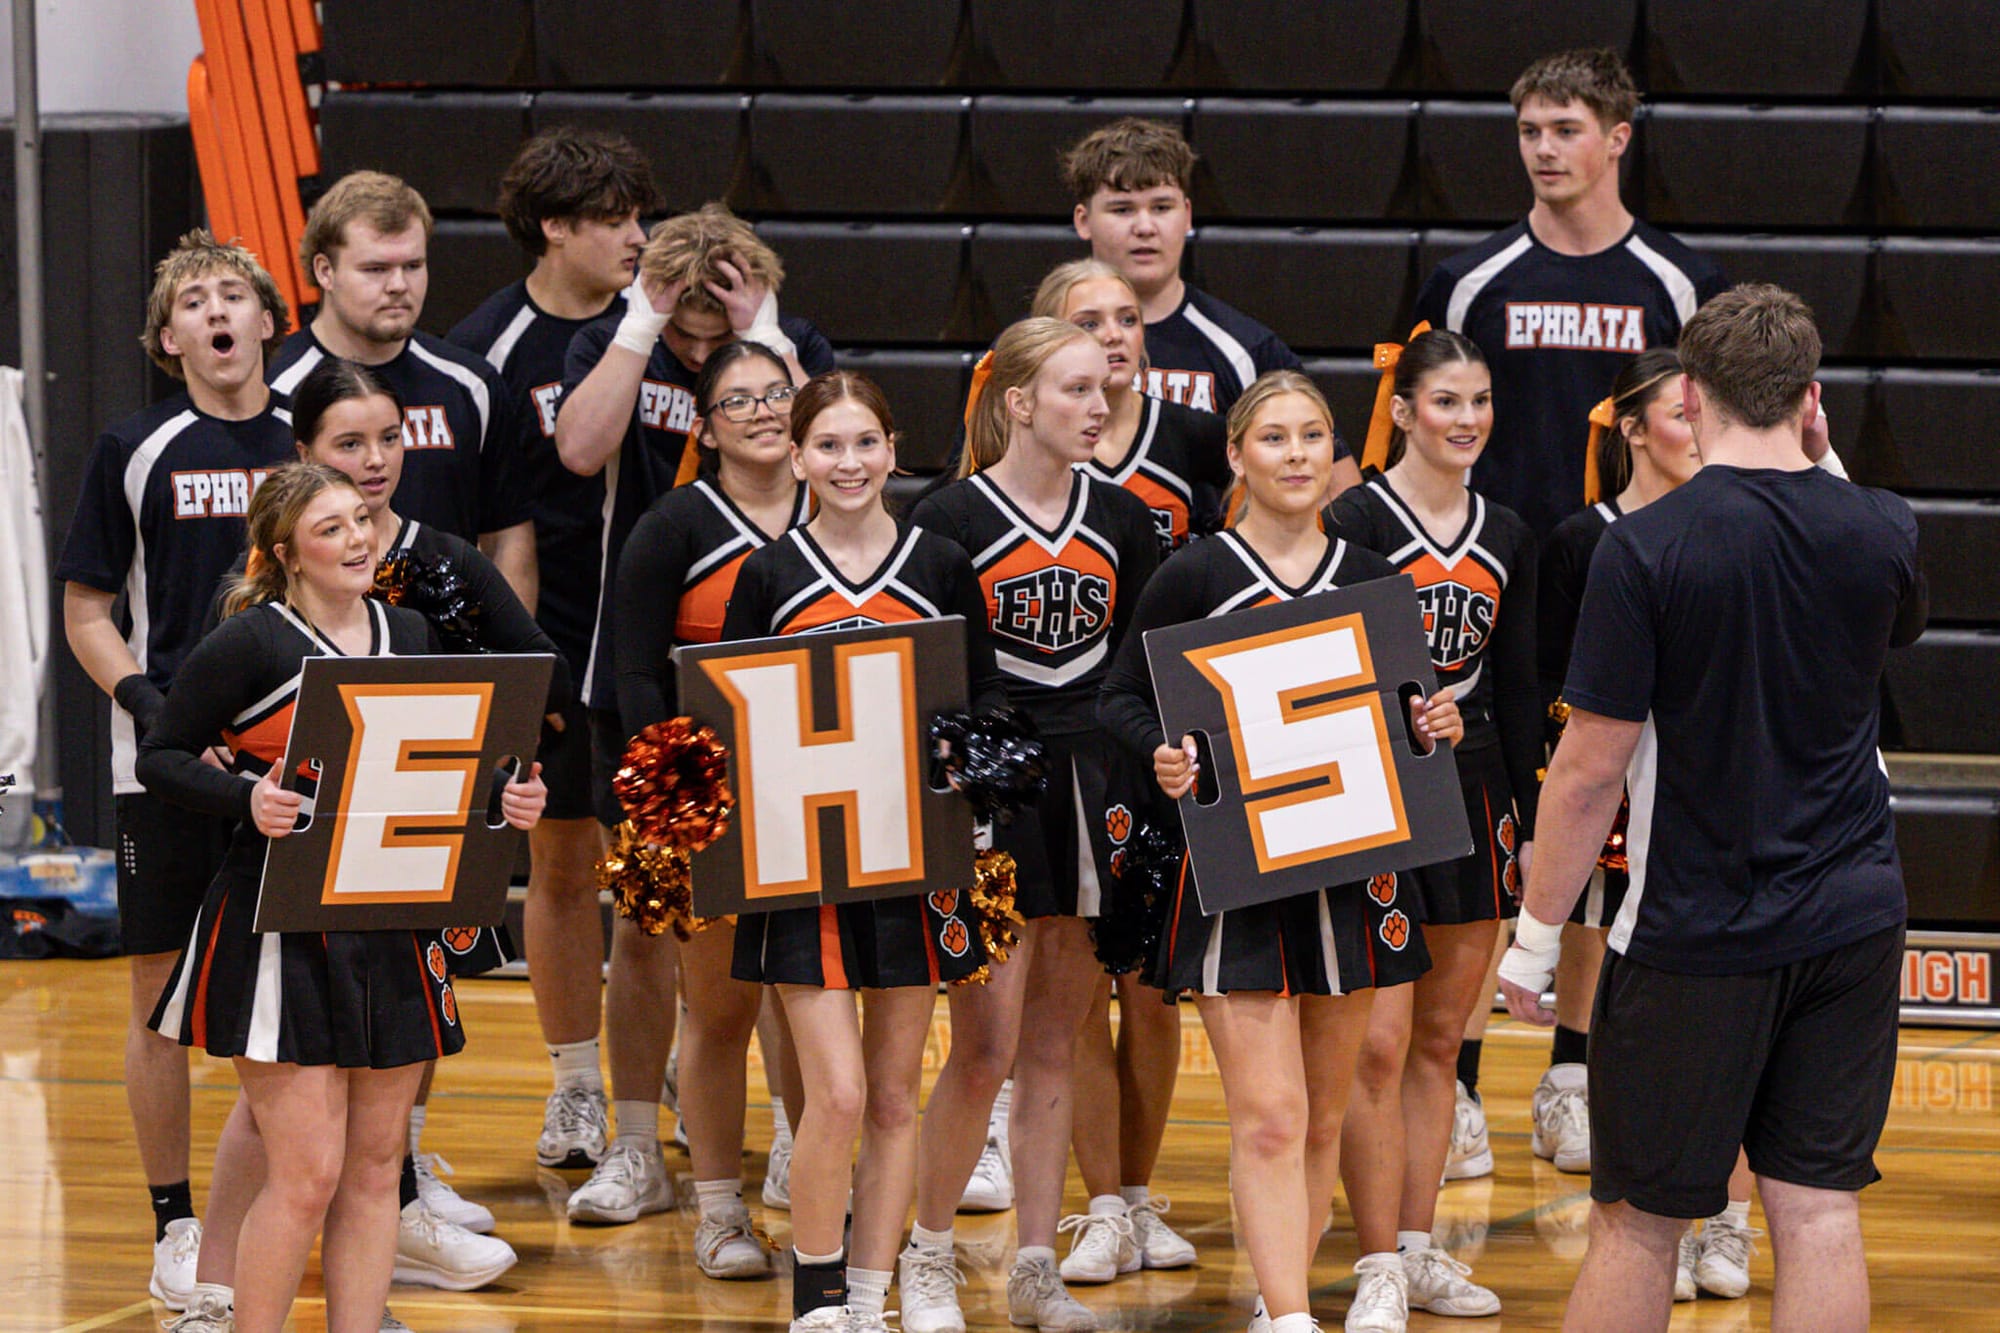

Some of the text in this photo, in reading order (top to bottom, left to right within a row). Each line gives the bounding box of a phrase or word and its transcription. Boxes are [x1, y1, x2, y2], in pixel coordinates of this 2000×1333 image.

[1505, 302, 1646, 353] EPHRATA
[992, 564, 1110, 651] EHS
[321, 682, 495, 905] E
[697, 636, 925, 899] H
[1182, 612, 1411, 874] S
[1900, 950, 1991, 1003] IGH
